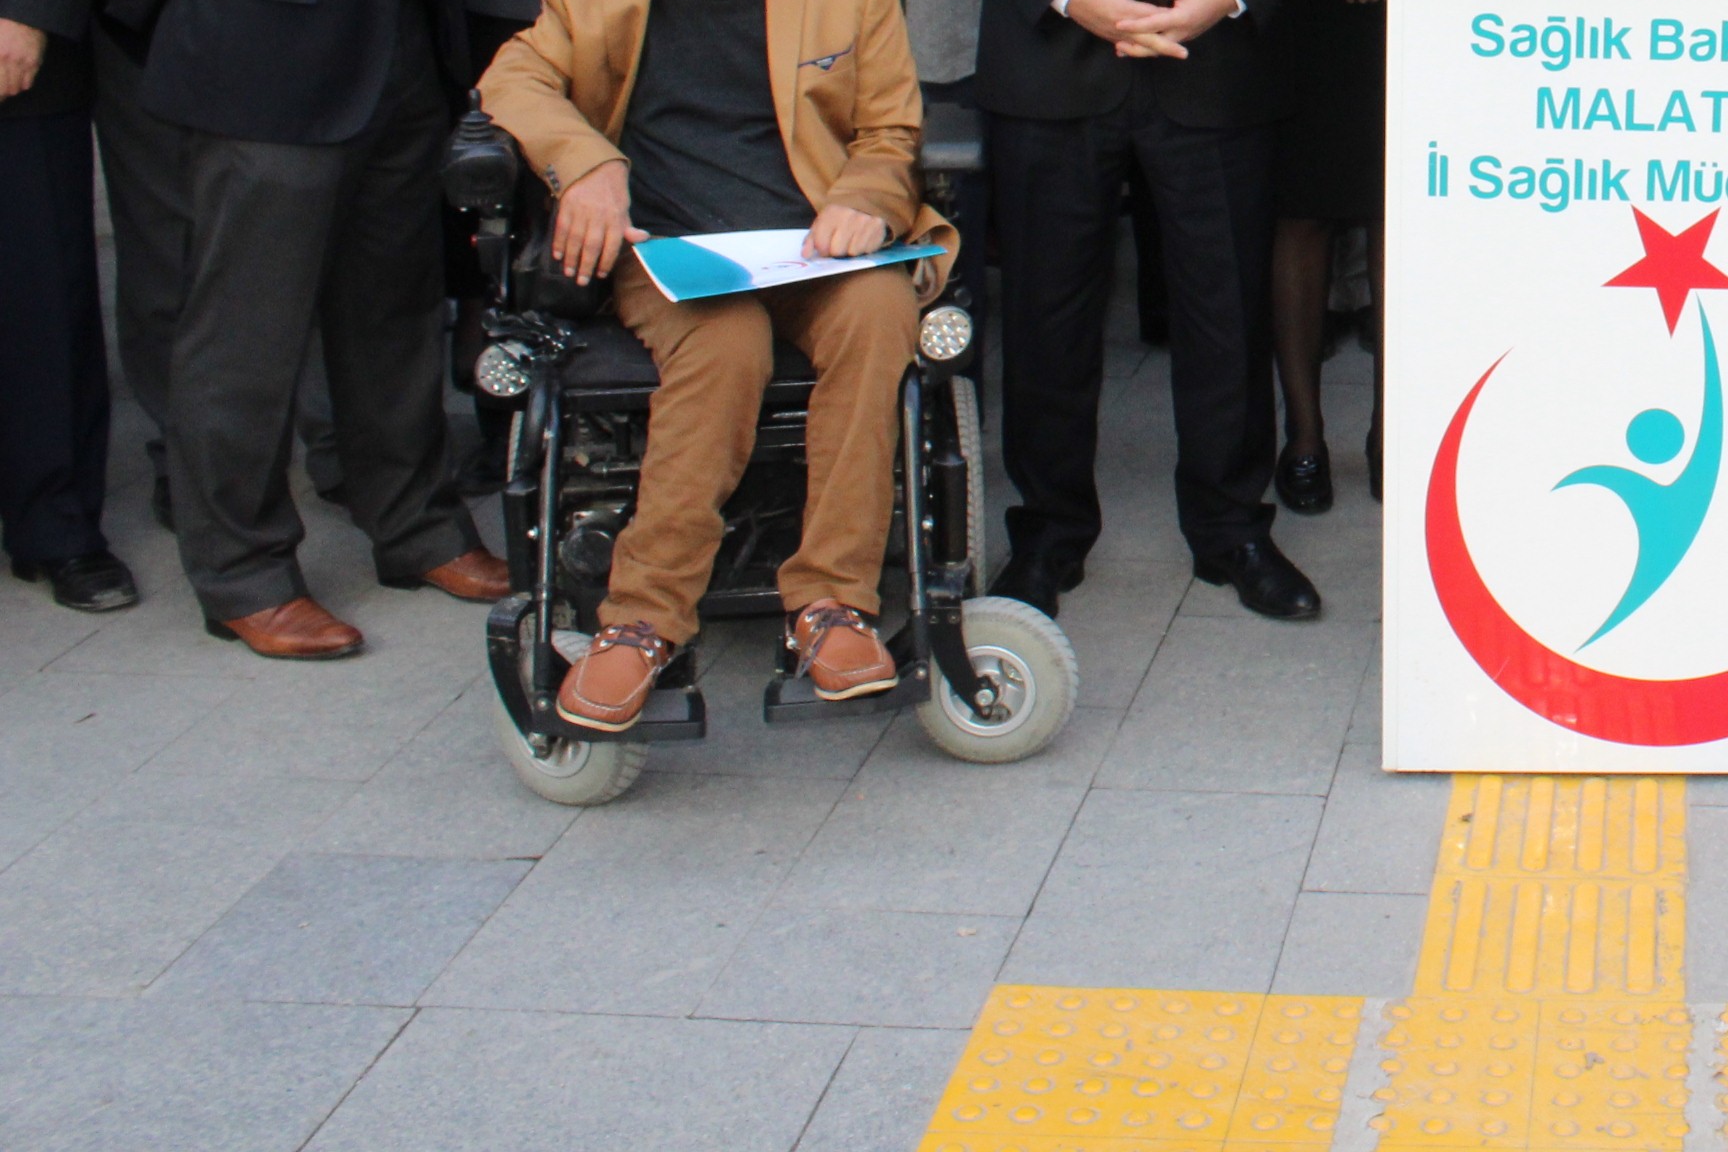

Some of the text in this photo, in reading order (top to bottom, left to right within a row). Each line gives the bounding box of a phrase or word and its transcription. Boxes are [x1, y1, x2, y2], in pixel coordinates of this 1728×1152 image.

[1470, 13, 1632, 72] Sağlık
[1426, 141, 1449, 197] İl
[1468, 155, 1631, 213] Sağlık
